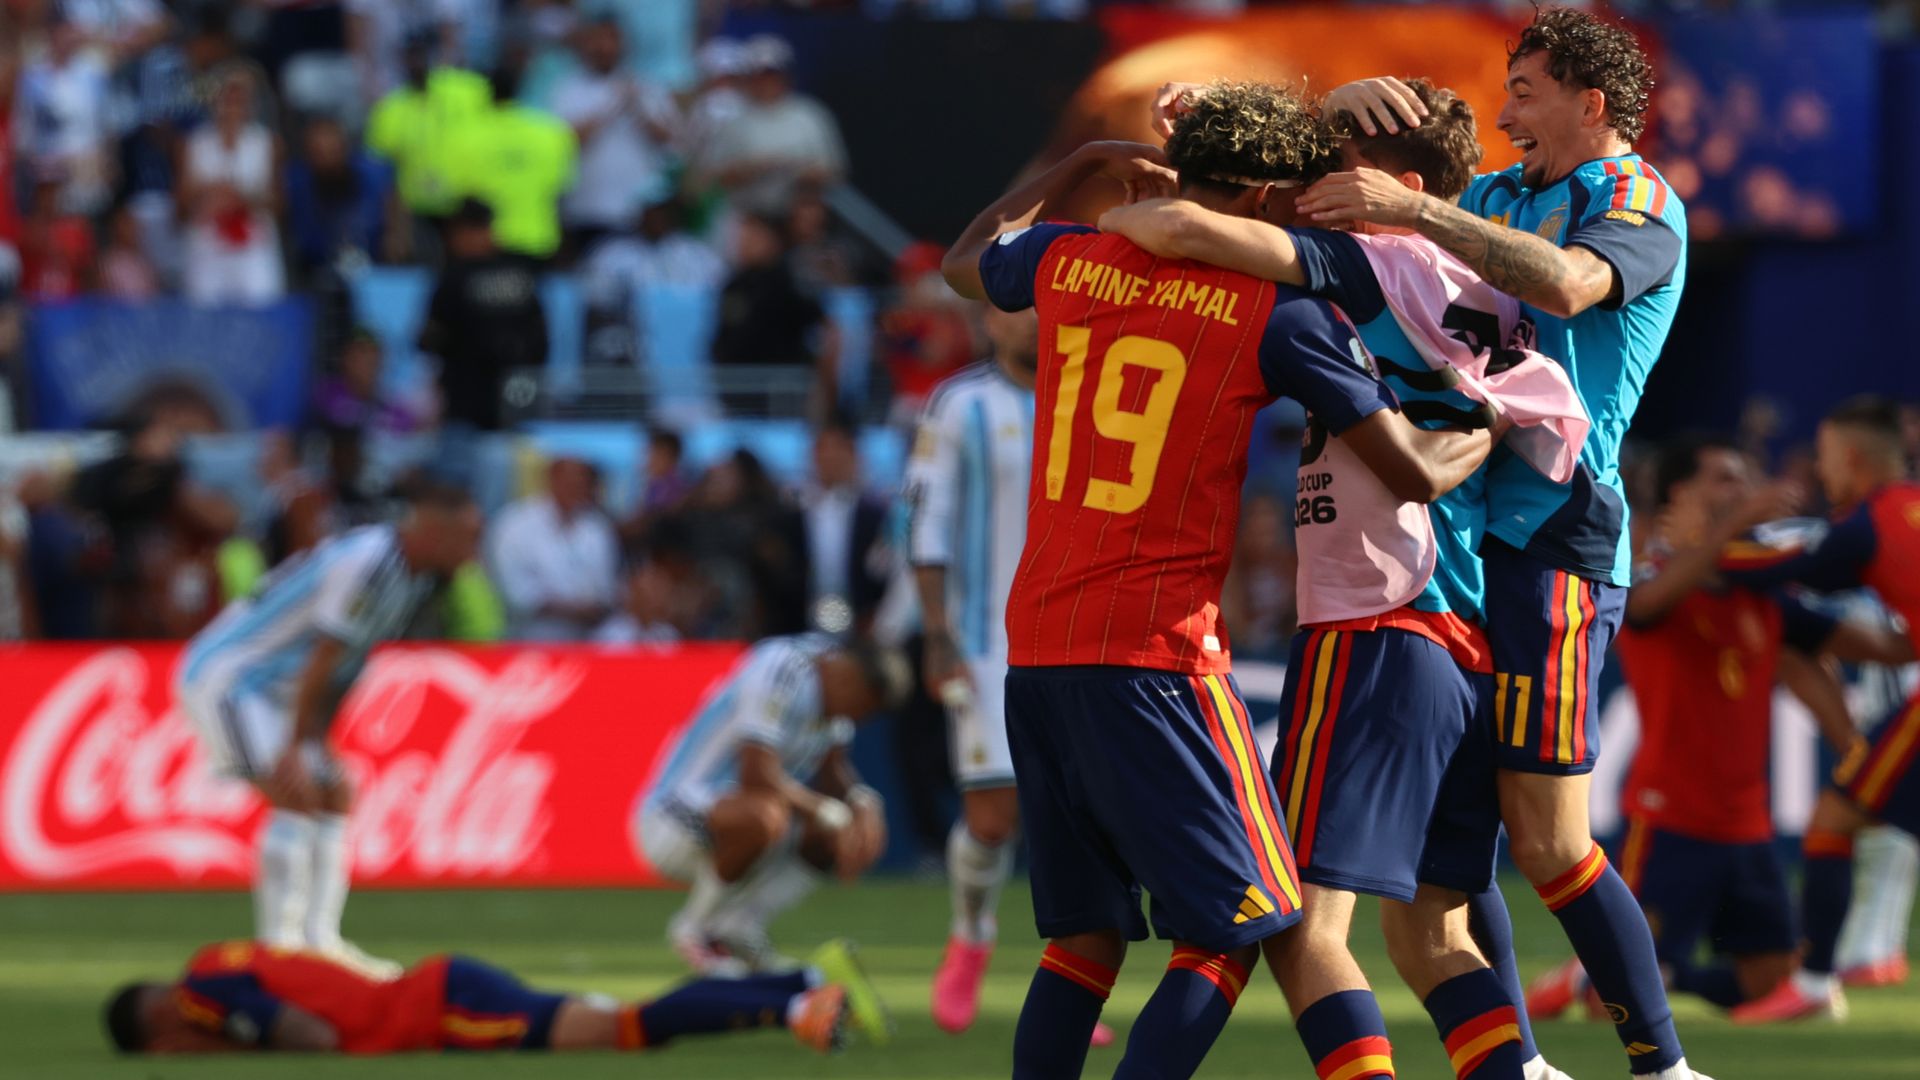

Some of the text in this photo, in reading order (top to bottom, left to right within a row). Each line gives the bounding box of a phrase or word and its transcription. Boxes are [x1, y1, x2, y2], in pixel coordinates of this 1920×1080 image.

[1051, 255, 1238, 326] LAMINE YAMAL
[1046, 324, 1187, 515] 19
[1295, 496, 1337, 528] 26
[1306, 473, 1333, 492] CUP
[1495, 672, 1532, 747] 11
[2, 648, 588, 877] Cocaola
